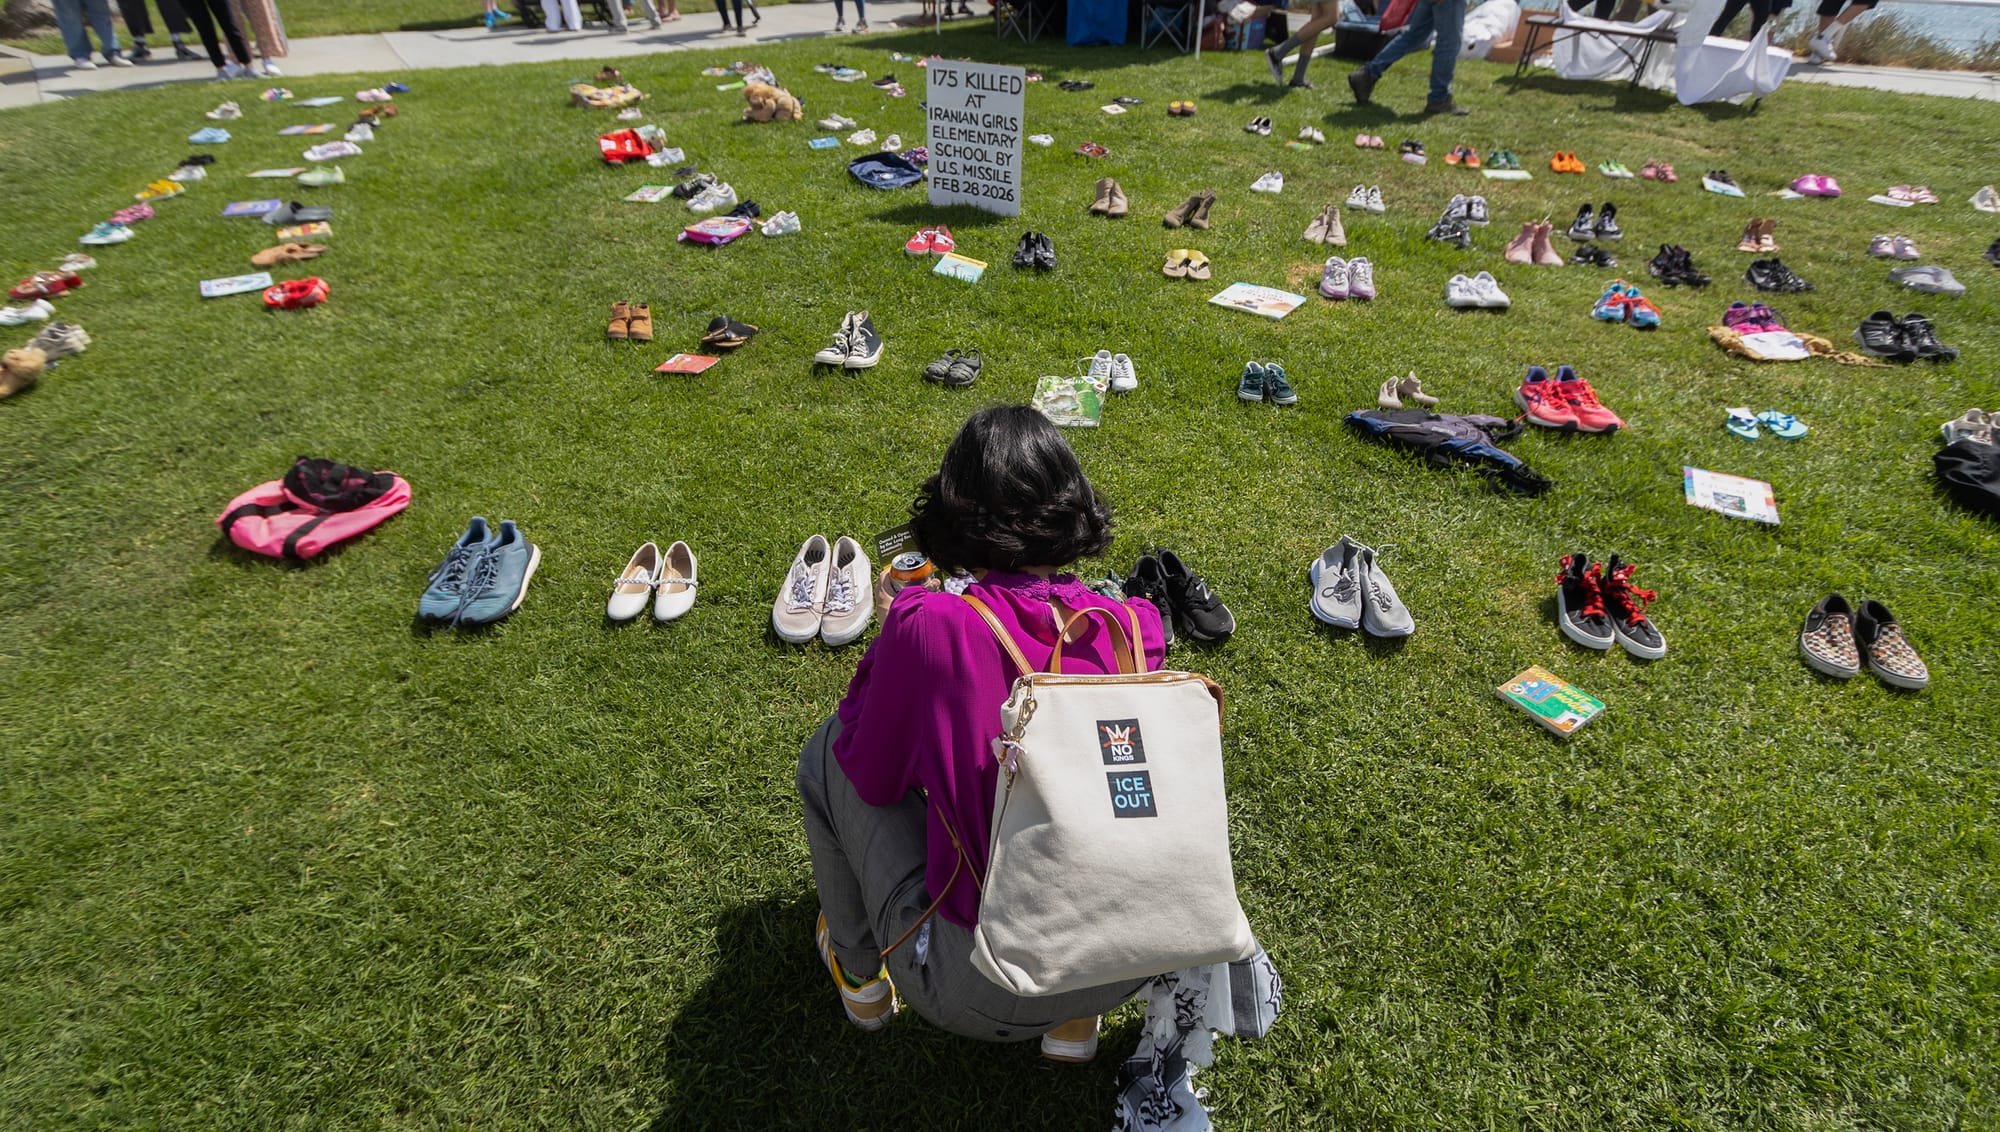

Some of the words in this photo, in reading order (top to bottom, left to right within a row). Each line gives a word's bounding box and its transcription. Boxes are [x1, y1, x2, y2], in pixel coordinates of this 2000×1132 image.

[933, 69, 958, 87] 175
[965, 72, 1022, 94] KILLED
[965, 94, 986, 108] AT
[929, 107, 978, 125] IRANIAN
[982, 114, 1018, 132] GIRLS
[933, 126, 1017, 148] ELEMENTARY
[935, 143, 992, 162] SCHOOL
[996, 152, 1013, 166] BY
[936, 160, 959, 175] U.S.
[963, 164, 1012, 184] MISSILE
[933, 177, 959, 193] FEB
[963, 181, 979, 195] 28
[982, 184, 1014, 201] 2026
[1111, 745, 1132, 755] NO
[1116, 777, 1145, 791] ICE
[1115, 793, 1150, 808] OUT
